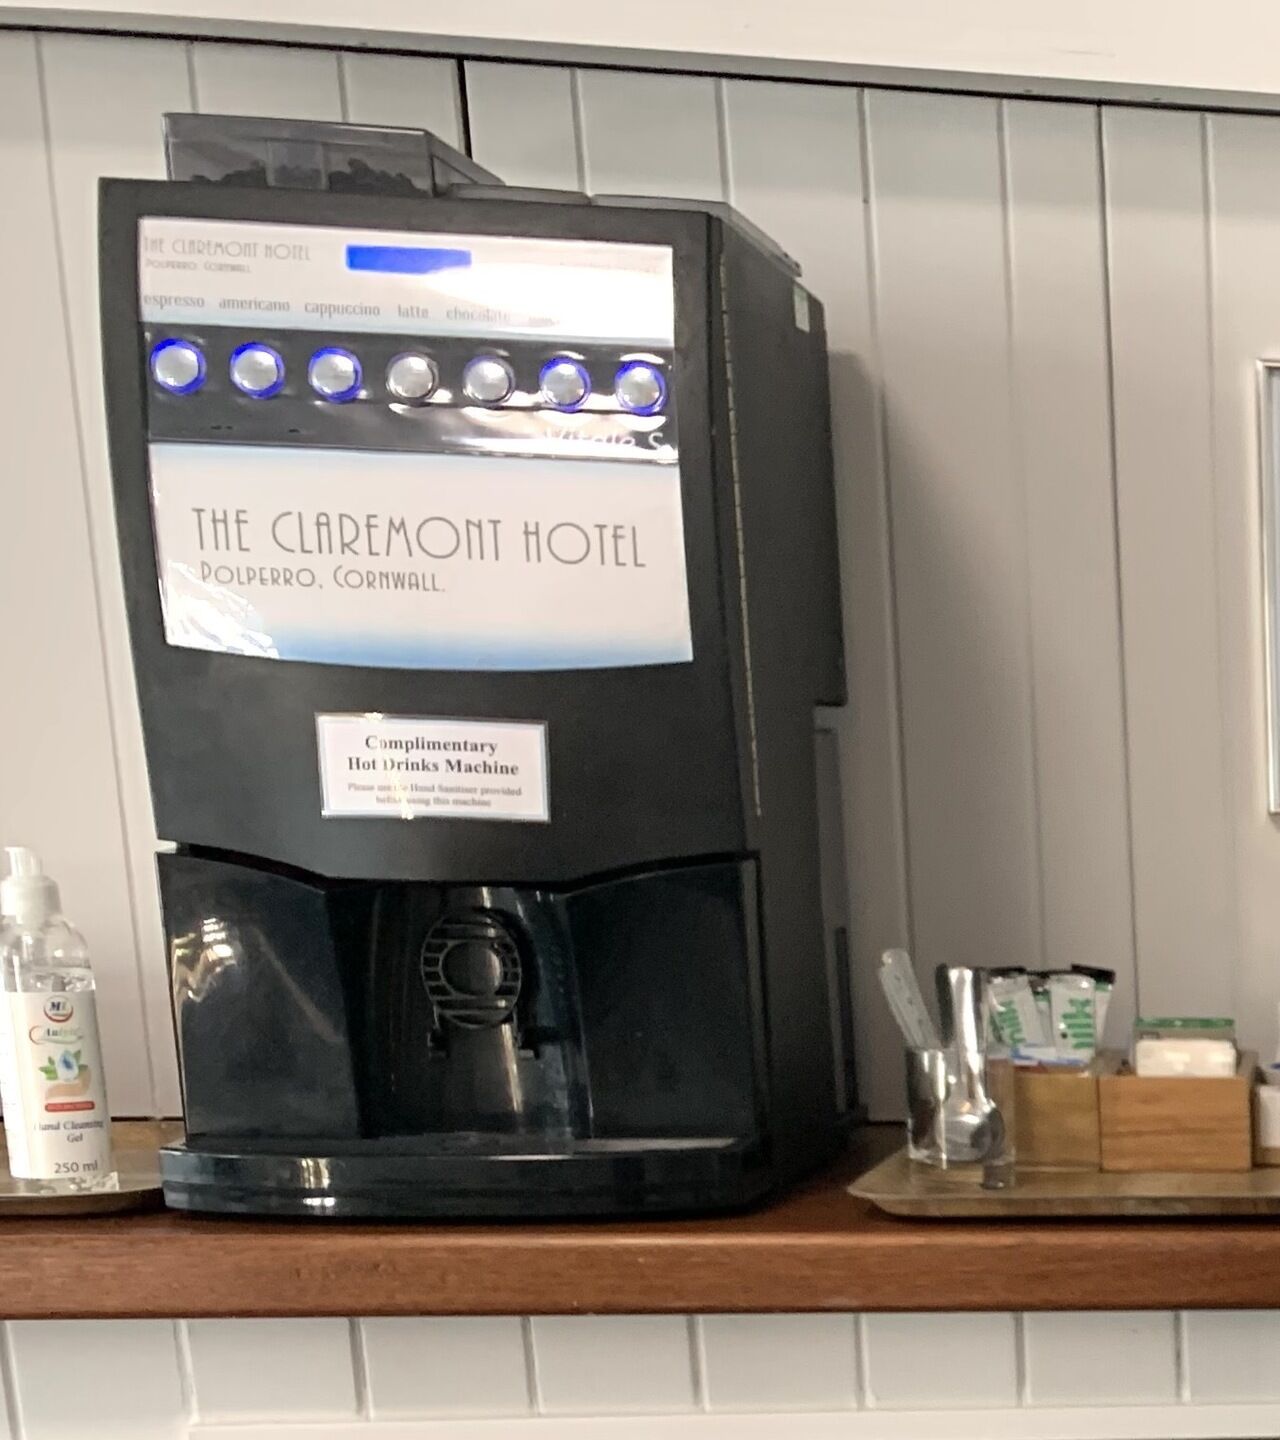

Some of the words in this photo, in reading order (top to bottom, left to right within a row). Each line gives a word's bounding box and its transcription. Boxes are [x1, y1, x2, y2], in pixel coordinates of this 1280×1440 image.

[143, 294, 205, 310] espresso
[219, 296, 290, 313] americano
[304, 301, 381, 319] cappuccino
[397, 304, 429, 320] latte
[190, 507, 251, 553] THE
[272, 510, 502, 563] CLAREMONT
[523, 520, 647, 569] HOTEL
[365, 735, 498, 757] Complimentary
[347, 757, 376, 772] Hot
[384, 758, 440, 773] Drinks
[445, 759, 520, 776] Machine
[66, 1133, 84, 1143] Gel
[54, 1161, 80, 1173] 250
[82, 1160, 99, 1172] ml
